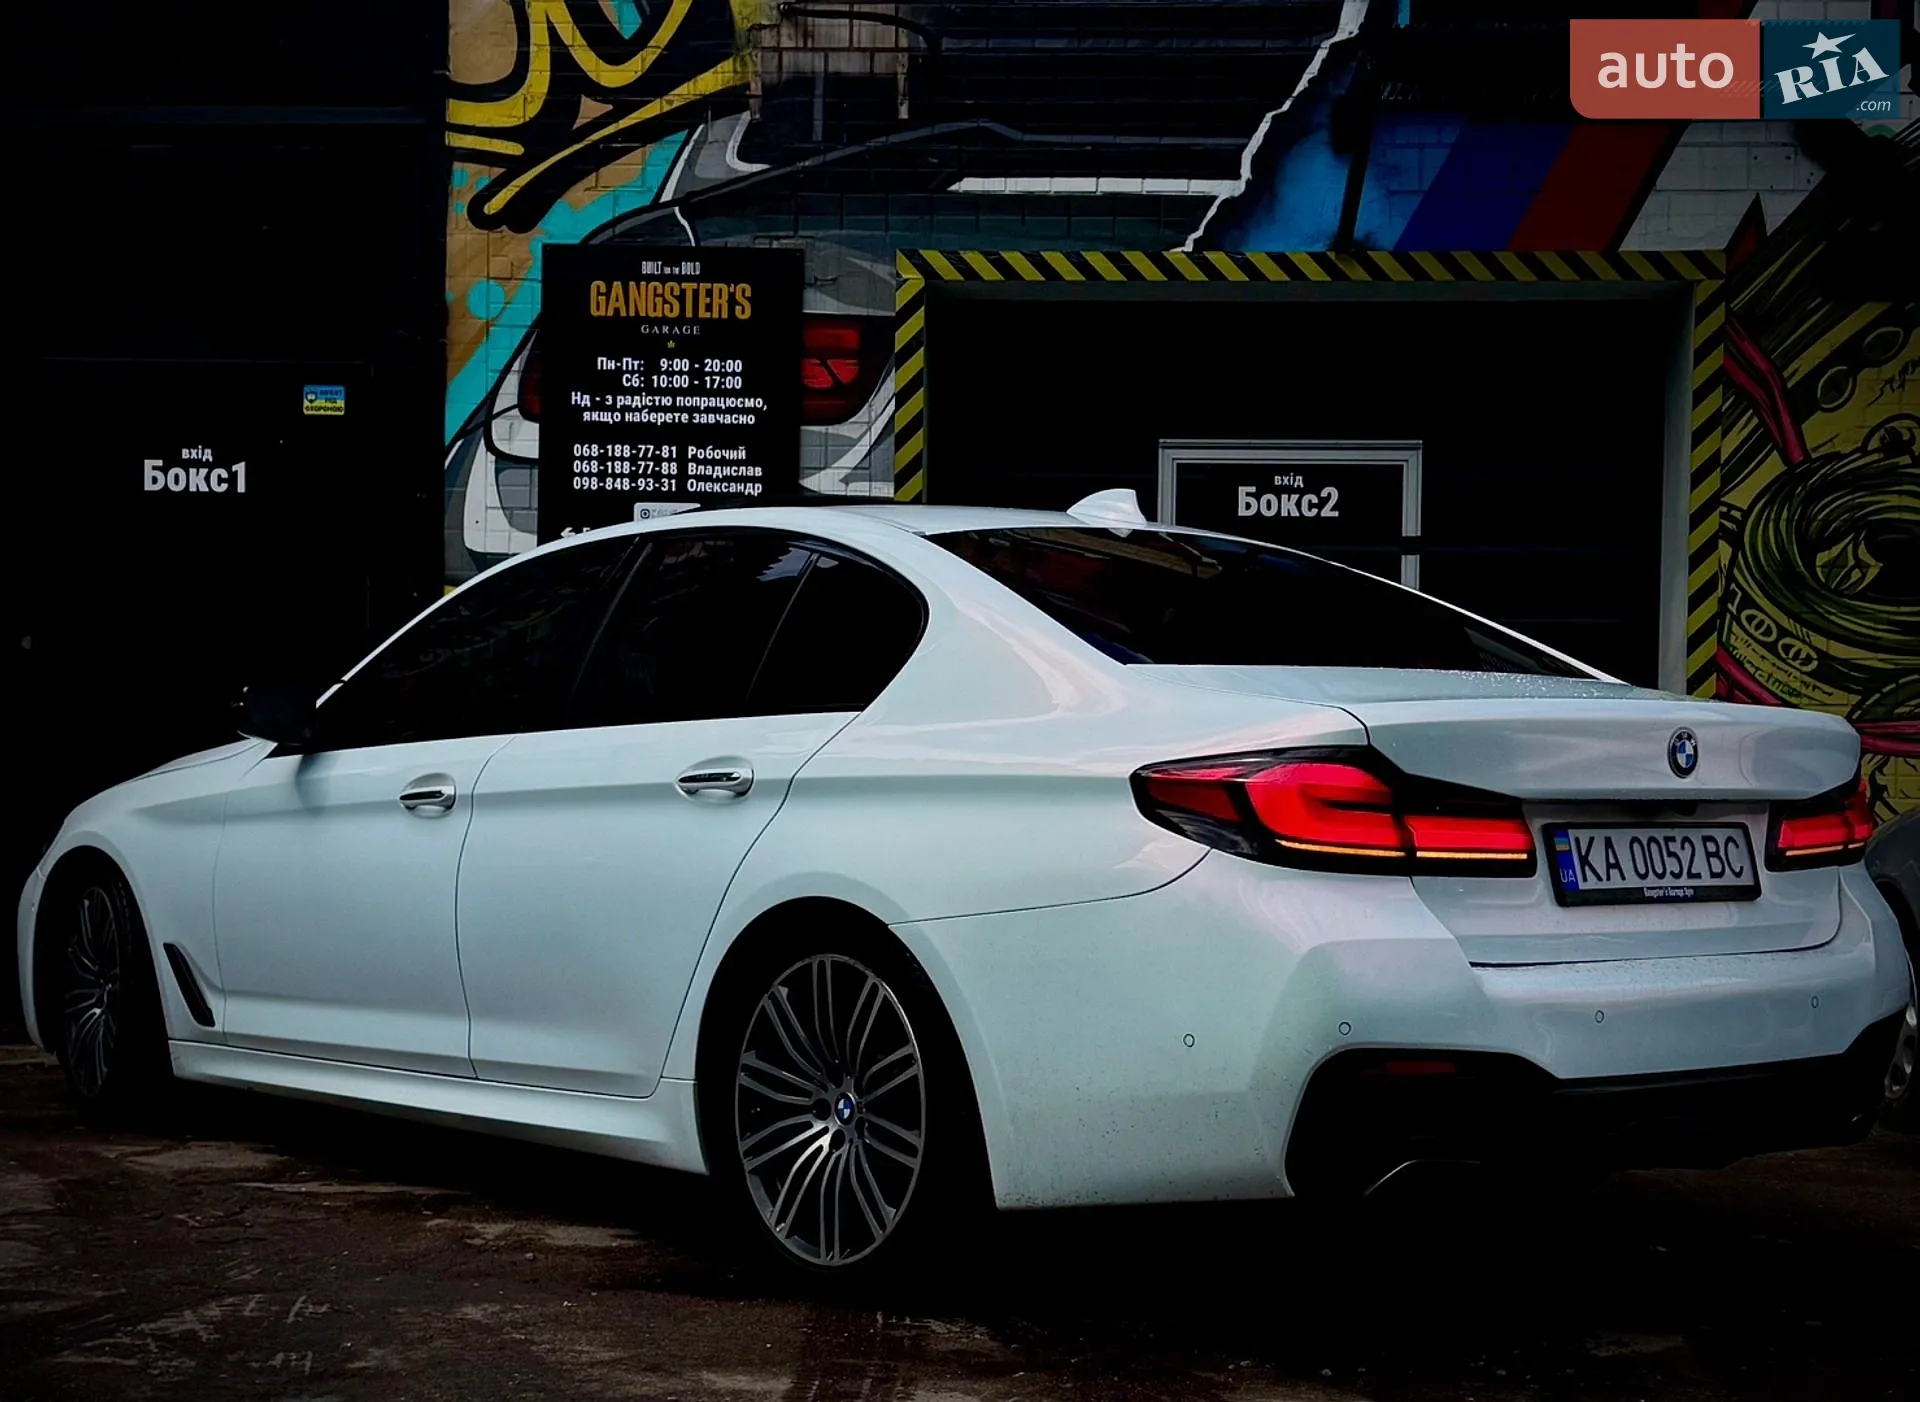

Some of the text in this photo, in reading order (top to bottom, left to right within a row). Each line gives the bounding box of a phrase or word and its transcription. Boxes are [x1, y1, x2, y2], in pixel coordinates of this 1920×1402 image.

[641, 260, 662, 274] BUILT
[681, 261, 701, 275] BOLD
[590, 280, 752, 319] GANGSTER'S
[640, 325, 701, 335] GARAGE
[597, 357, 644, 371] Пн-Пт:
[660, 358, 689, 372] 9:00
[704, 359, 743, 373] 20:00
[622, 374, 645, 387] Сб:
[652, 375, 690, 388] 10:00
[704, 376, 743, 389] 17:00
[571, 392, 591, 407] Нд
[616, 392, 673, 409] радістю
[676, 397, 768, 411] попрацюємо,
[583, 410, 756, 425] якщо наберете завчасно
[181, 445, 213, 462] вхід
[573, 444, 747, 459] 068-188-77-81 Робочий
[144, 459, 246, 493] Бокс1
[573, 460, 763, 478] 068-188-77-88 Владислав
[573, 476, 763, 496] 098-848-93-31 Олександр
[1274, 472, 1304, 488] вхід
[1237, 485, 1339, 517] Бокс2
[1574, 835, 1745, 882] KA 0052 BC
[1560, 868, 1576, 883] UA
